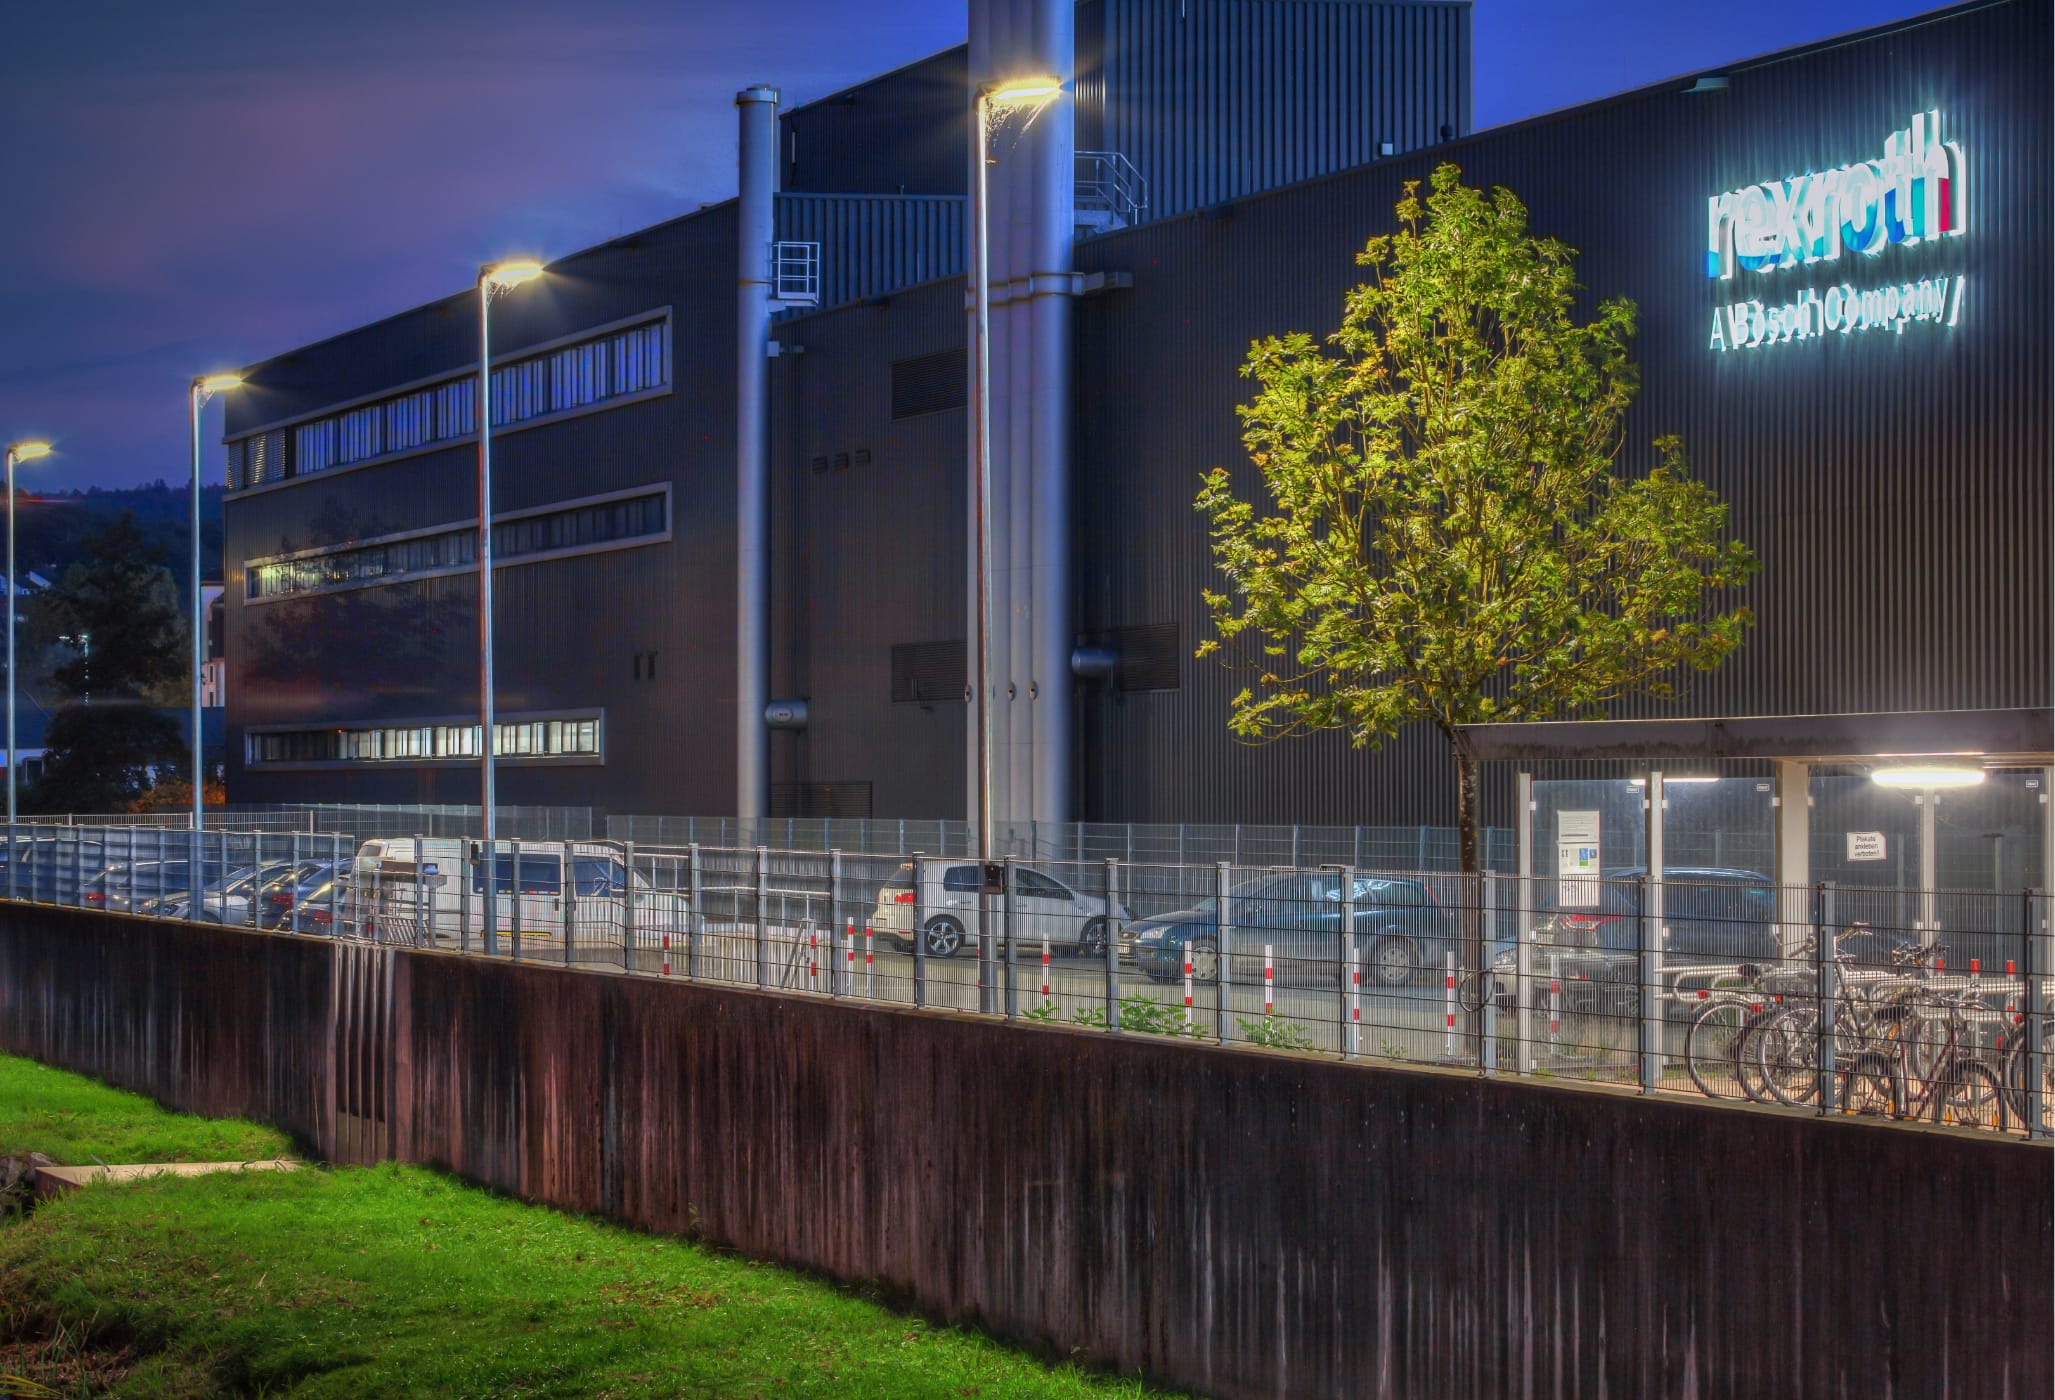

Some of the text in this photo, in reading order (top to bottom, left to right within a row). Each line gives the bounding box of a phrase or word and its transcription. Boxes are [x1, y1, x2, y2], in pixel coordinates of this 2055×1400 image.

[1708, 109, 1966, 280] rexroth
[1709, 275, 1965, 351] A Bosch Company
